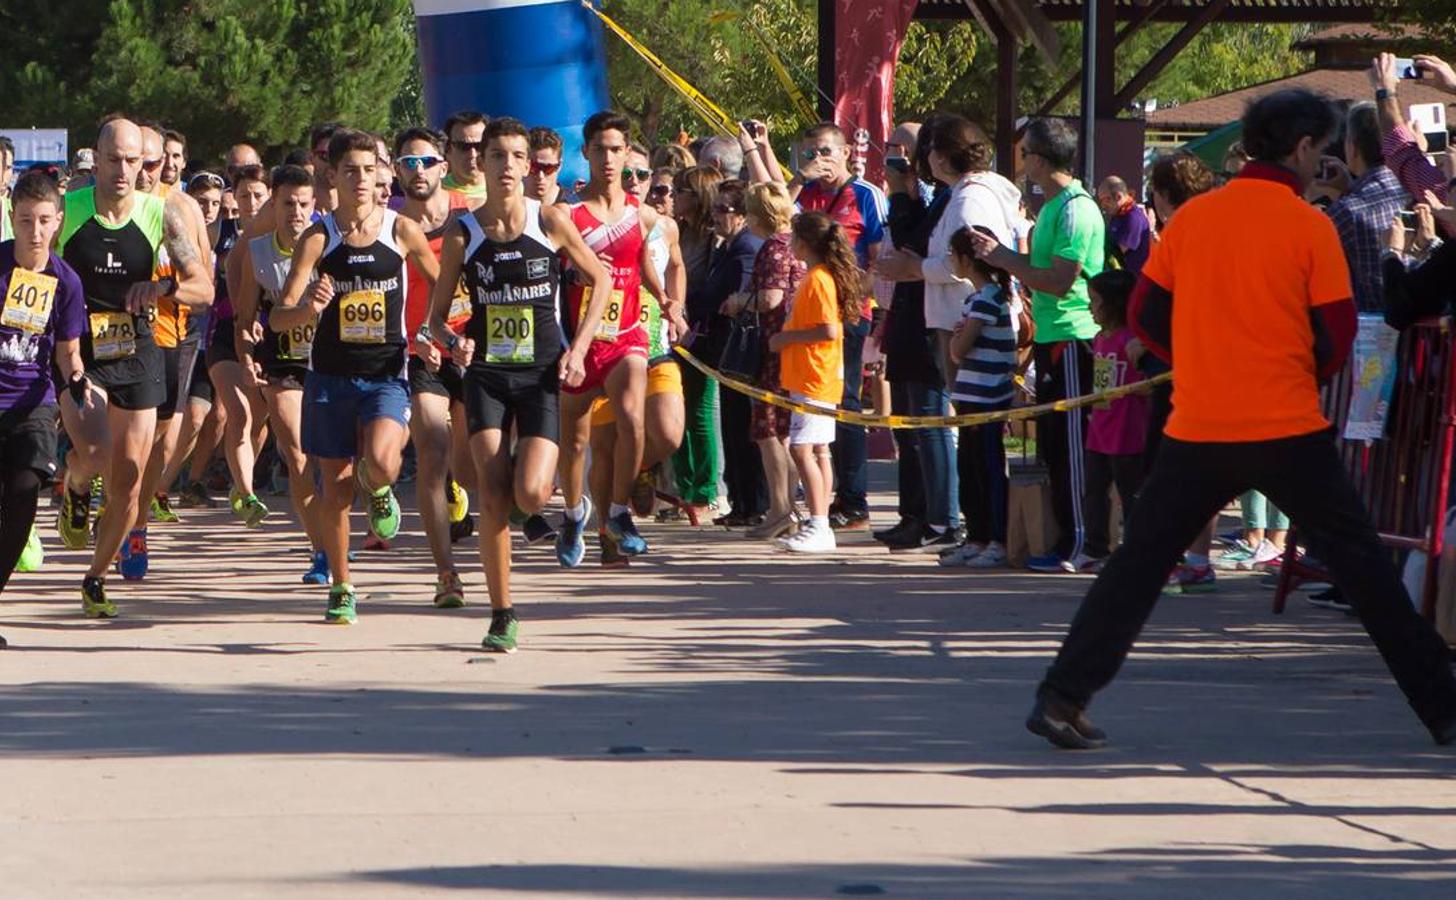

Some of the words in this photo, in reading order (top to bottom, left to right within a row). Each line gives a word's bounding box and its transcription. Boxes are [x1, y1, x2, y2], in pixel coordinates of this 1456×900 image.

[11, 283, 49, 312] 401
[345, 302, 383, 322] 696
[492, 318, 529, 339] 200
